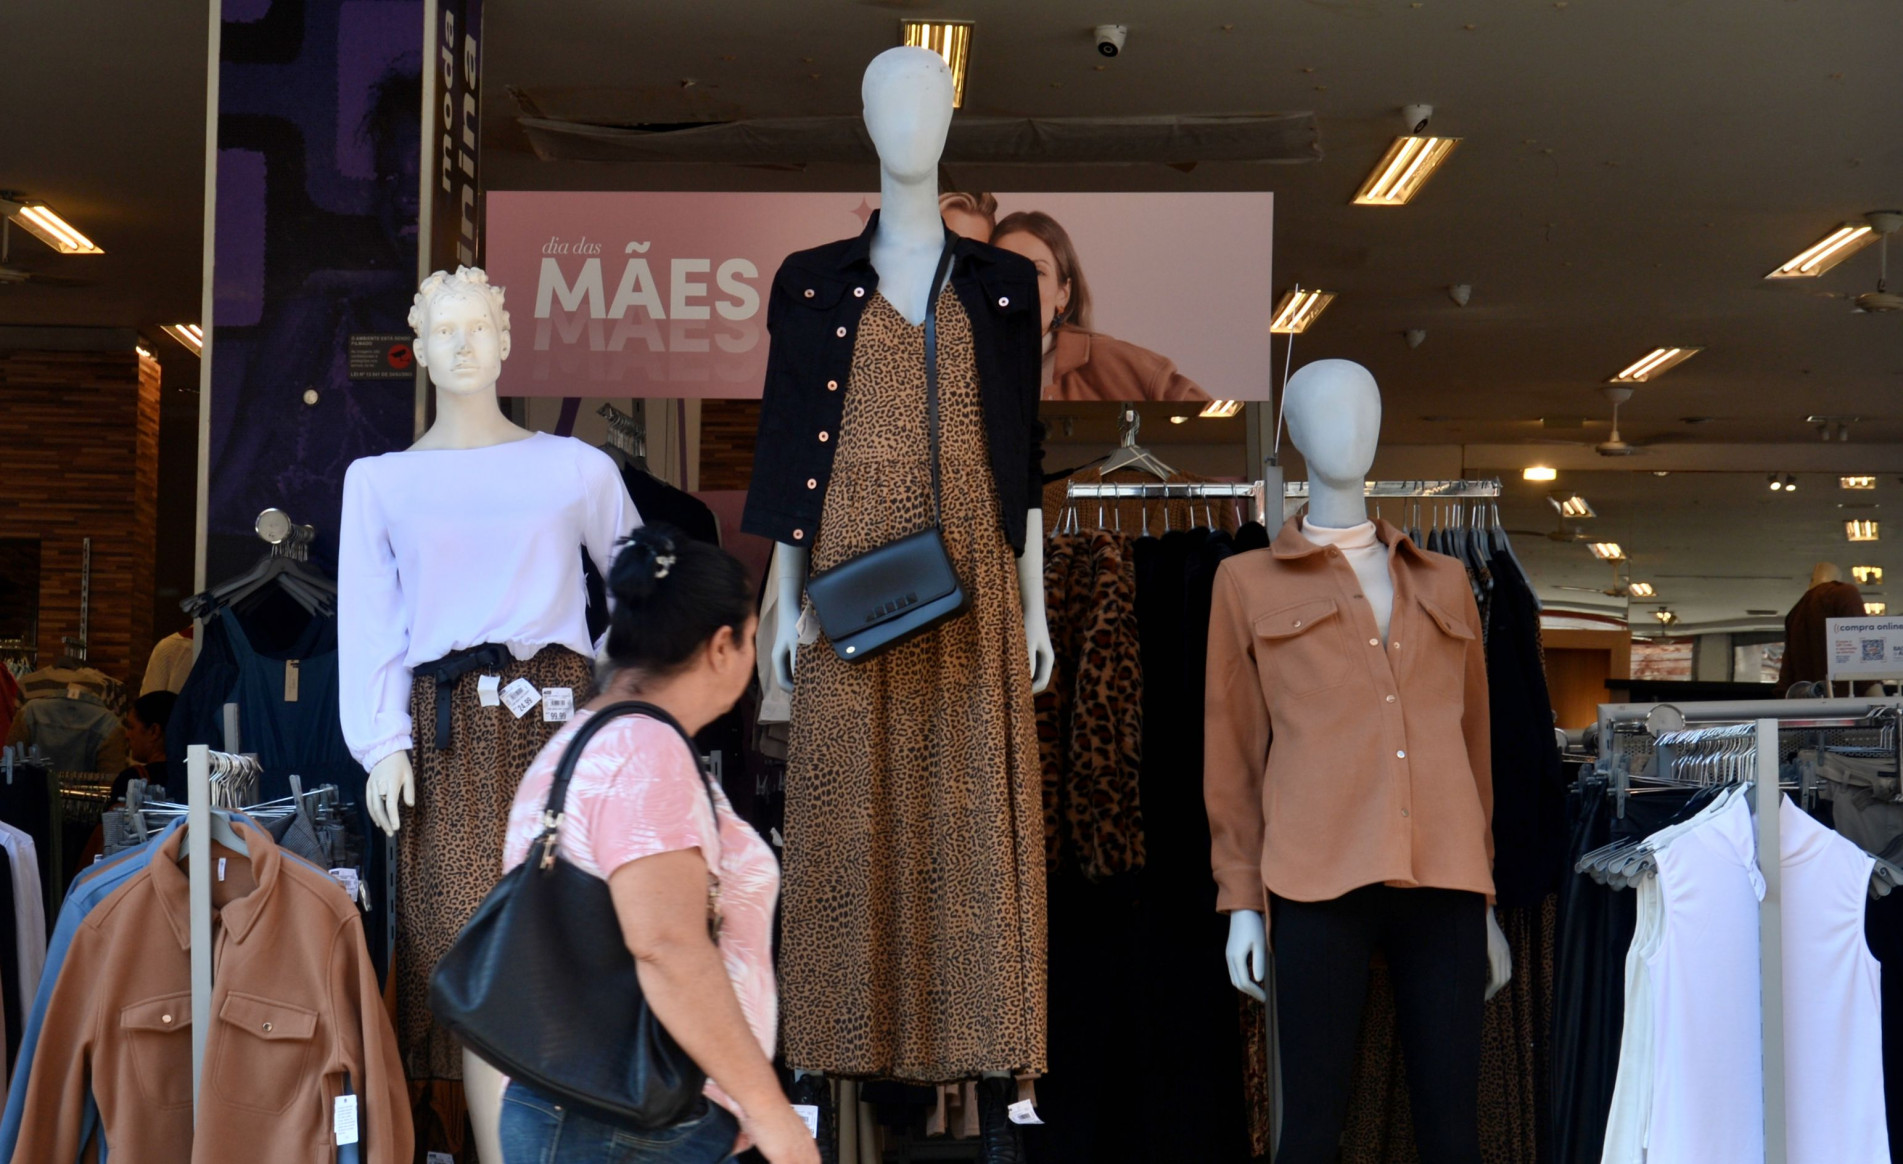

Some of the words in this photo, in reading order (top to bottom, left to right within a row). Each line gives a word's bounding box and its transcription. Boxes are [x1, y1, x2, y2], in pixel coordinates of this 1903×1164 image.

[442, 9, 454, 192] moda
[542, 236, 569, 255] dia
[572, 236, 602, 255] das
[534, 241, 760, 321] MÃES
[1840, 625, 1875, 633] compra
